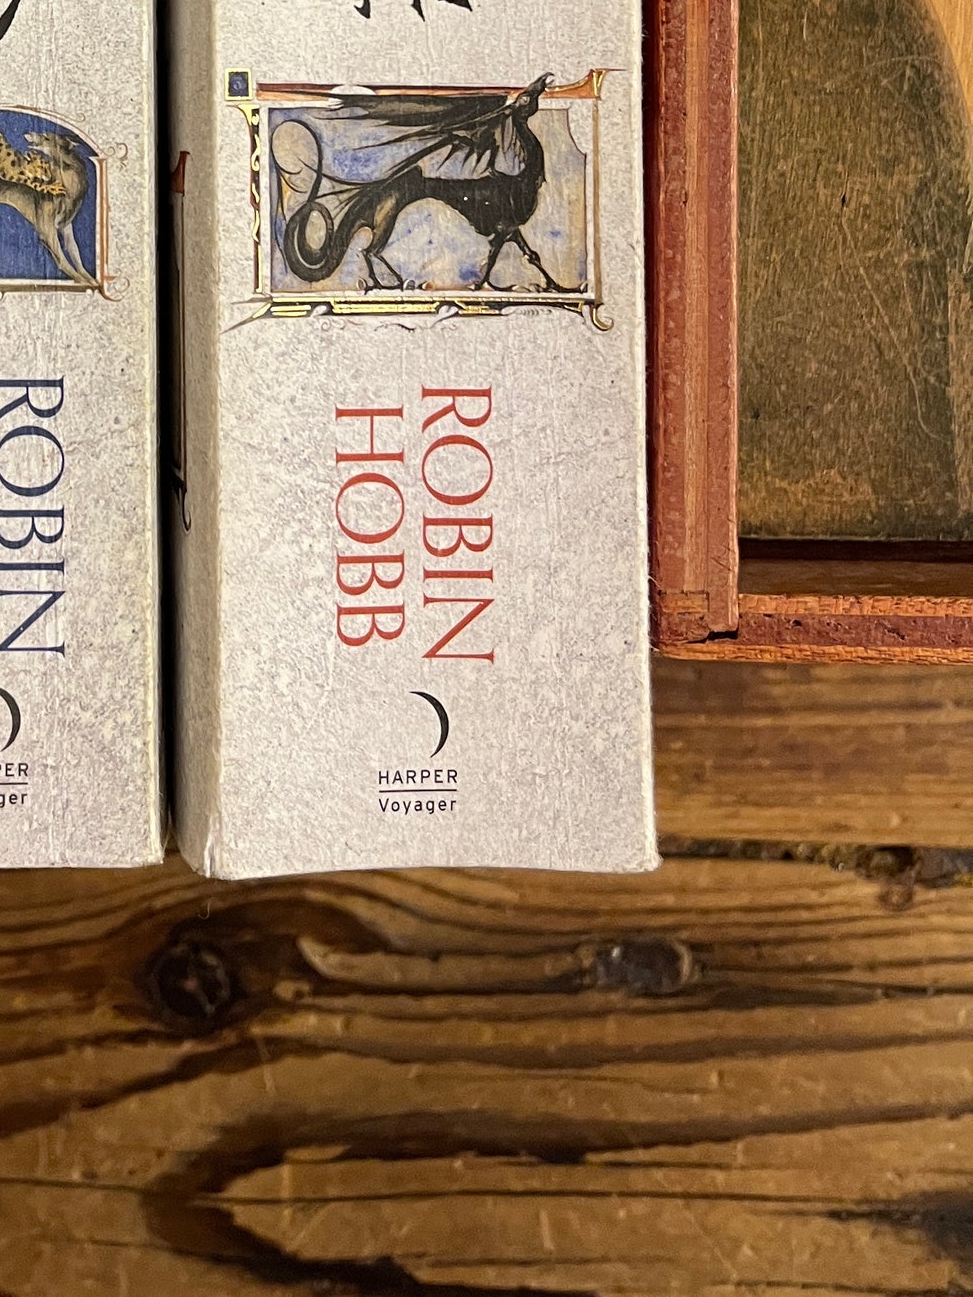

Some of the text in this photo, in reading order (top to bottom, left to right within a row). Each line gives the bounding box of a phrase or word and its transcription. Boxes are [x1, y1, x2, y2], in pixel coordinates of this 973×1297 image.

[335, 403, 405, 647] HOBB
[421, 384, 495, 665] ROBIN
[378, 769, 458, 784] HARPER
[378, 797, 457, 815] Voyager
